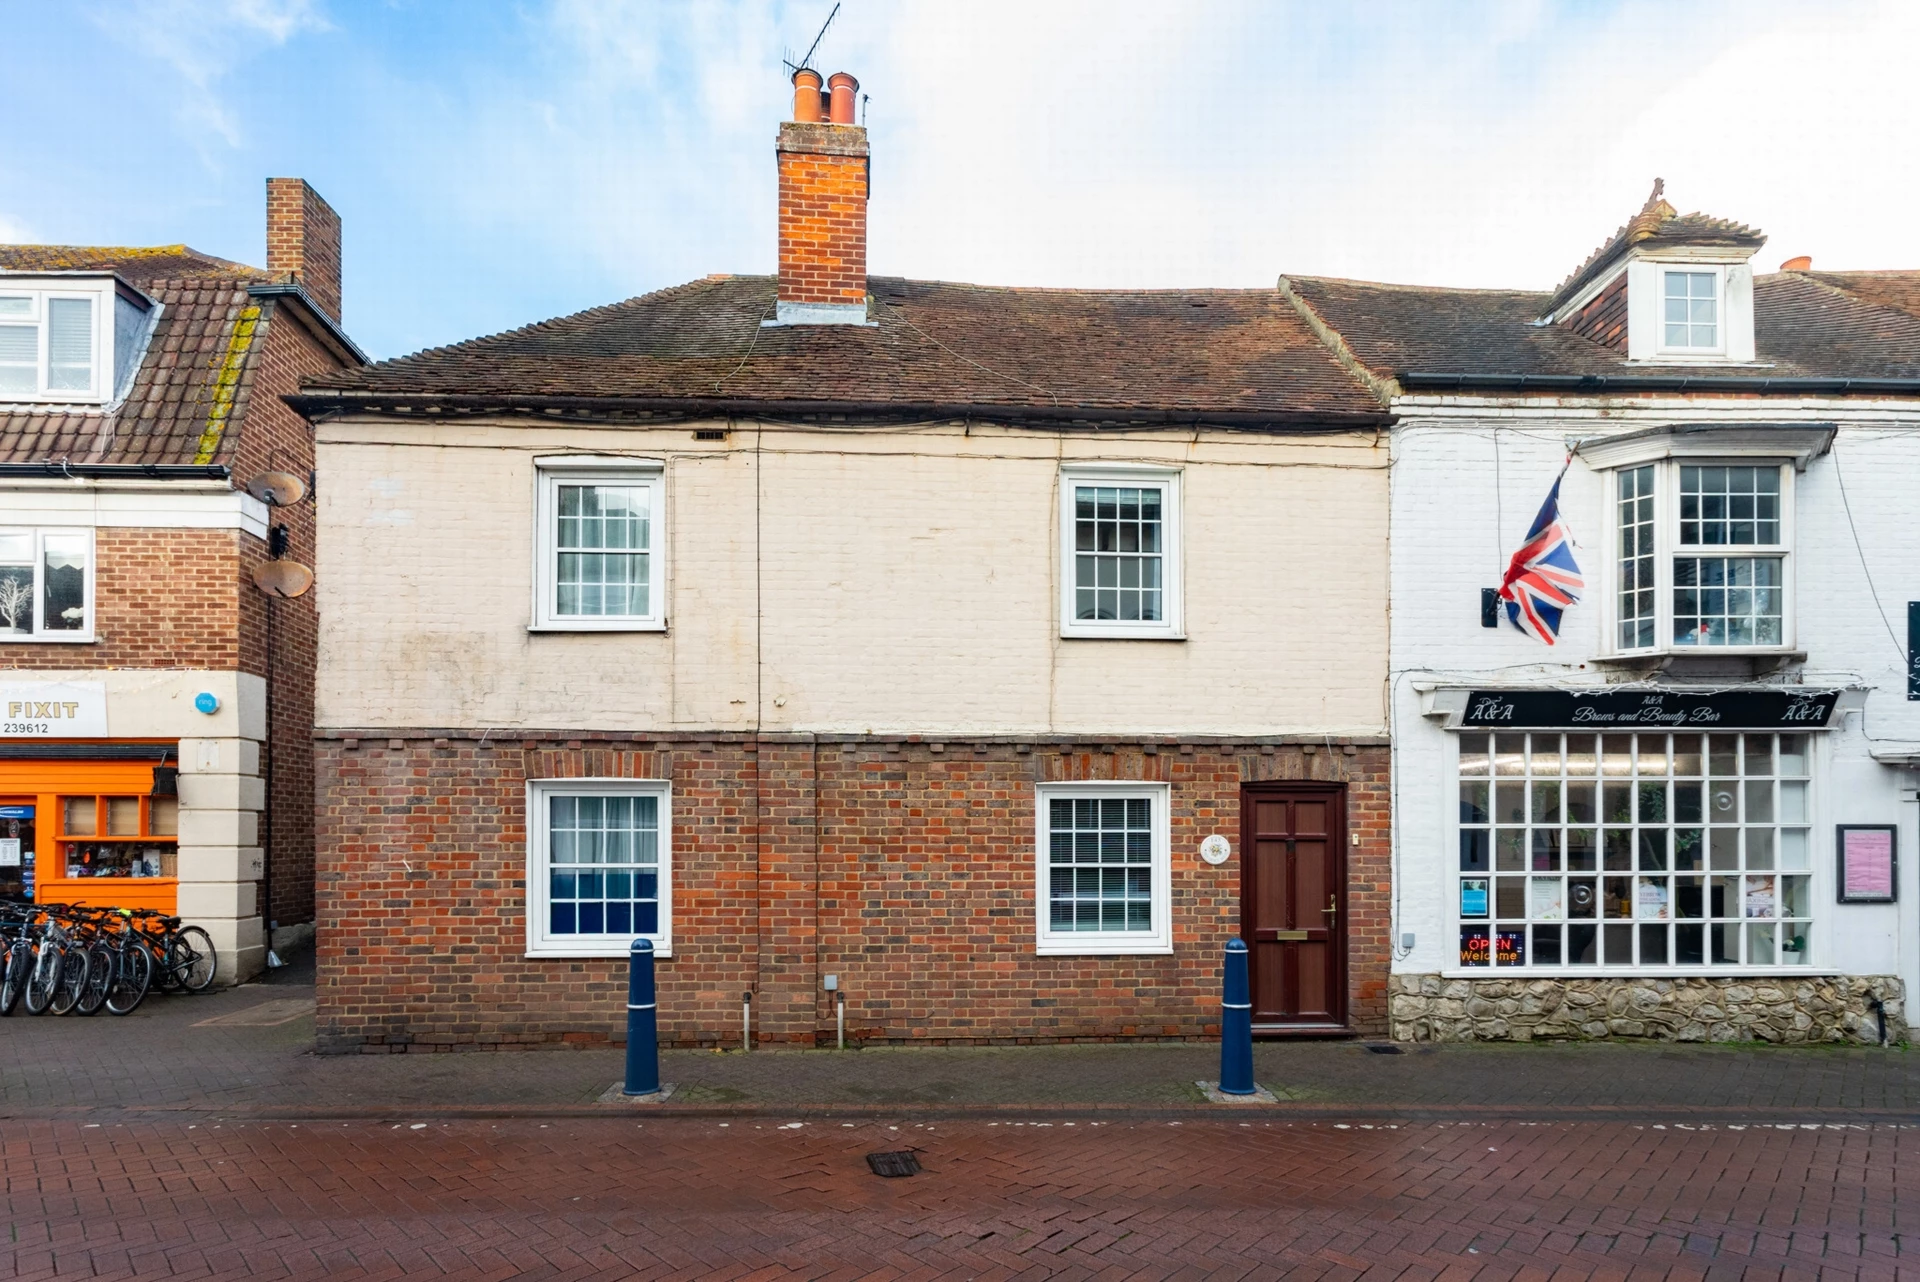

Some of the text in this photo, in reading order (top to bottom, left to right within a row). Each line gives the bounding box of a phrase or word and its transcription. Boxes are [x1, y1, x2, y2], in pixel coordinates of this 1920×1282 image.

[1642, 696, 1663, 704] A&A
[8, 701, 79, 718] FIXIT
[1469, 703, 1515, 720] A&A
[1572, 706, 1721, 726] Brows and Beauty Bar
[1781, 704, 1826, 720] A&A
[3, 723, 48, 733] 239612
[1460, 950, 1517, 960] Welcme
